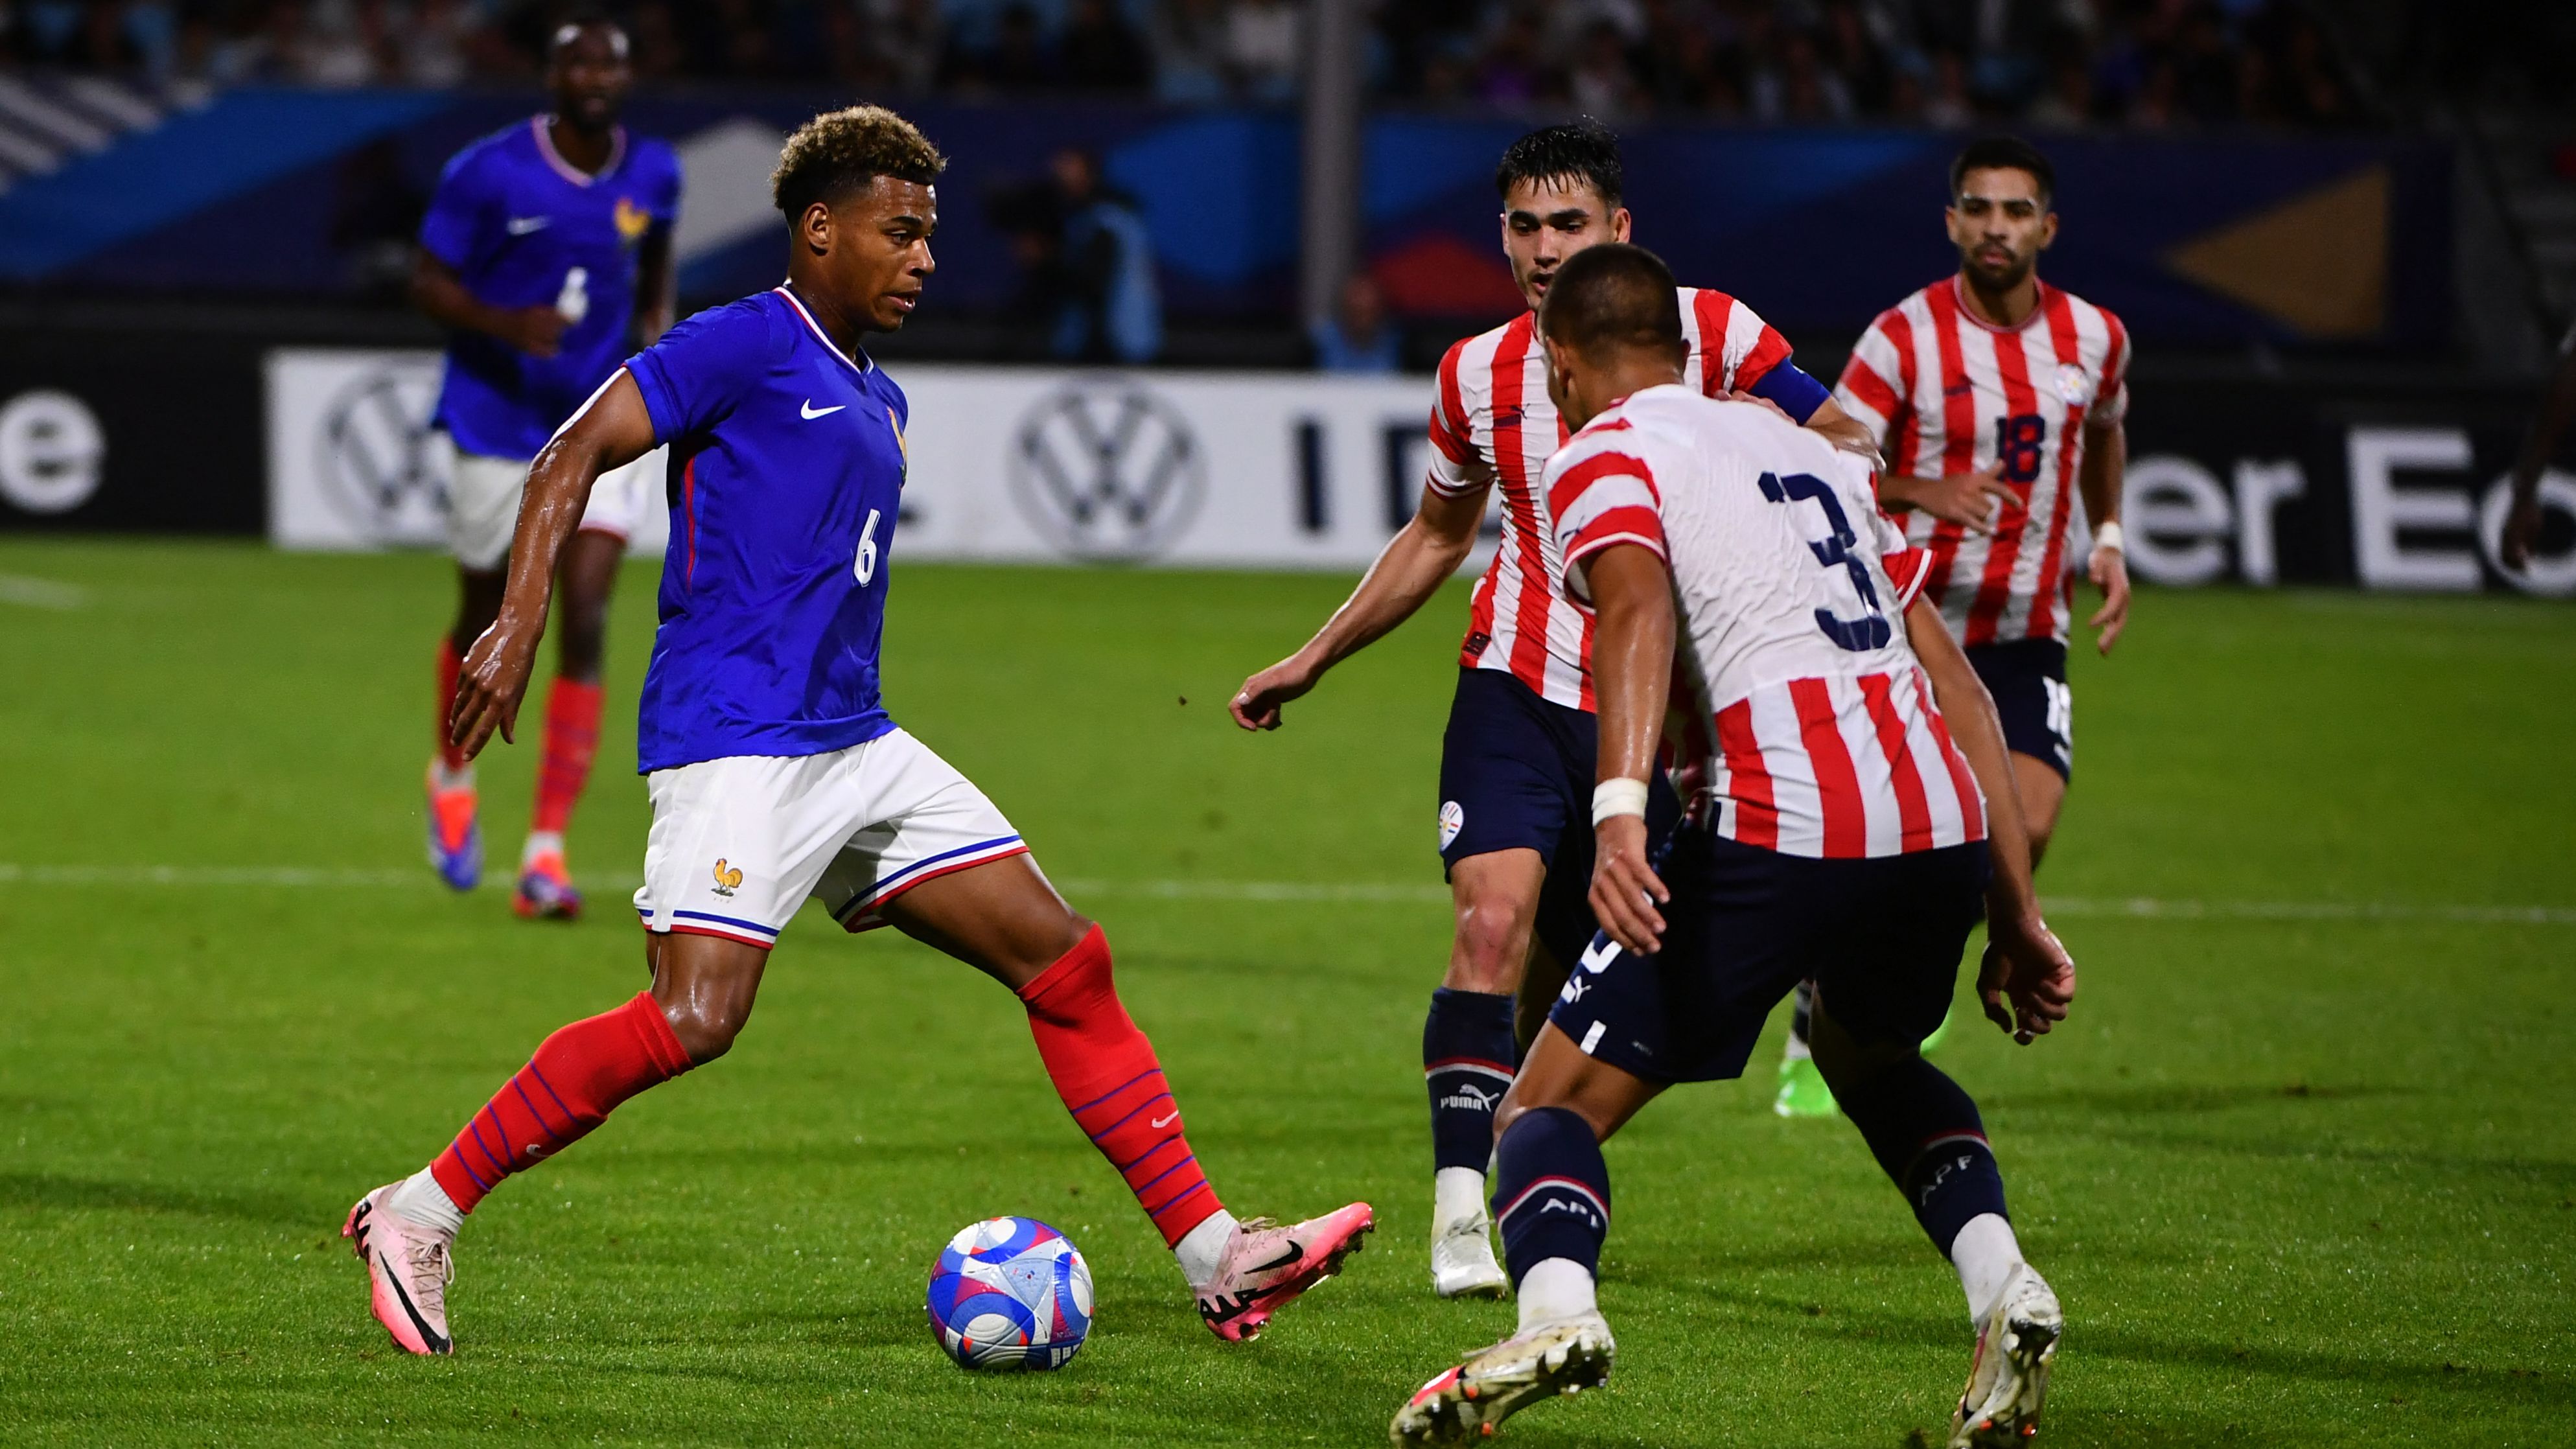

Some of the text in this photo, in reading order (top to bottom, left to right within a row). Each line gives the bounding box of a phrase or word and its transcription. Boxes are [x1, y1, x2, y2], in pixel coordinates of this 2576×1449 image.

[1995, 414, 2045, 482] 18
[853, 508, 881, 588] 6
[2070, 454, 2306, 586] er
[1758, 471, 1891, 652] 3
[1440, 1095, 1483, 1111] PUMA
[1921, 1155, 1973, 1207] APF
